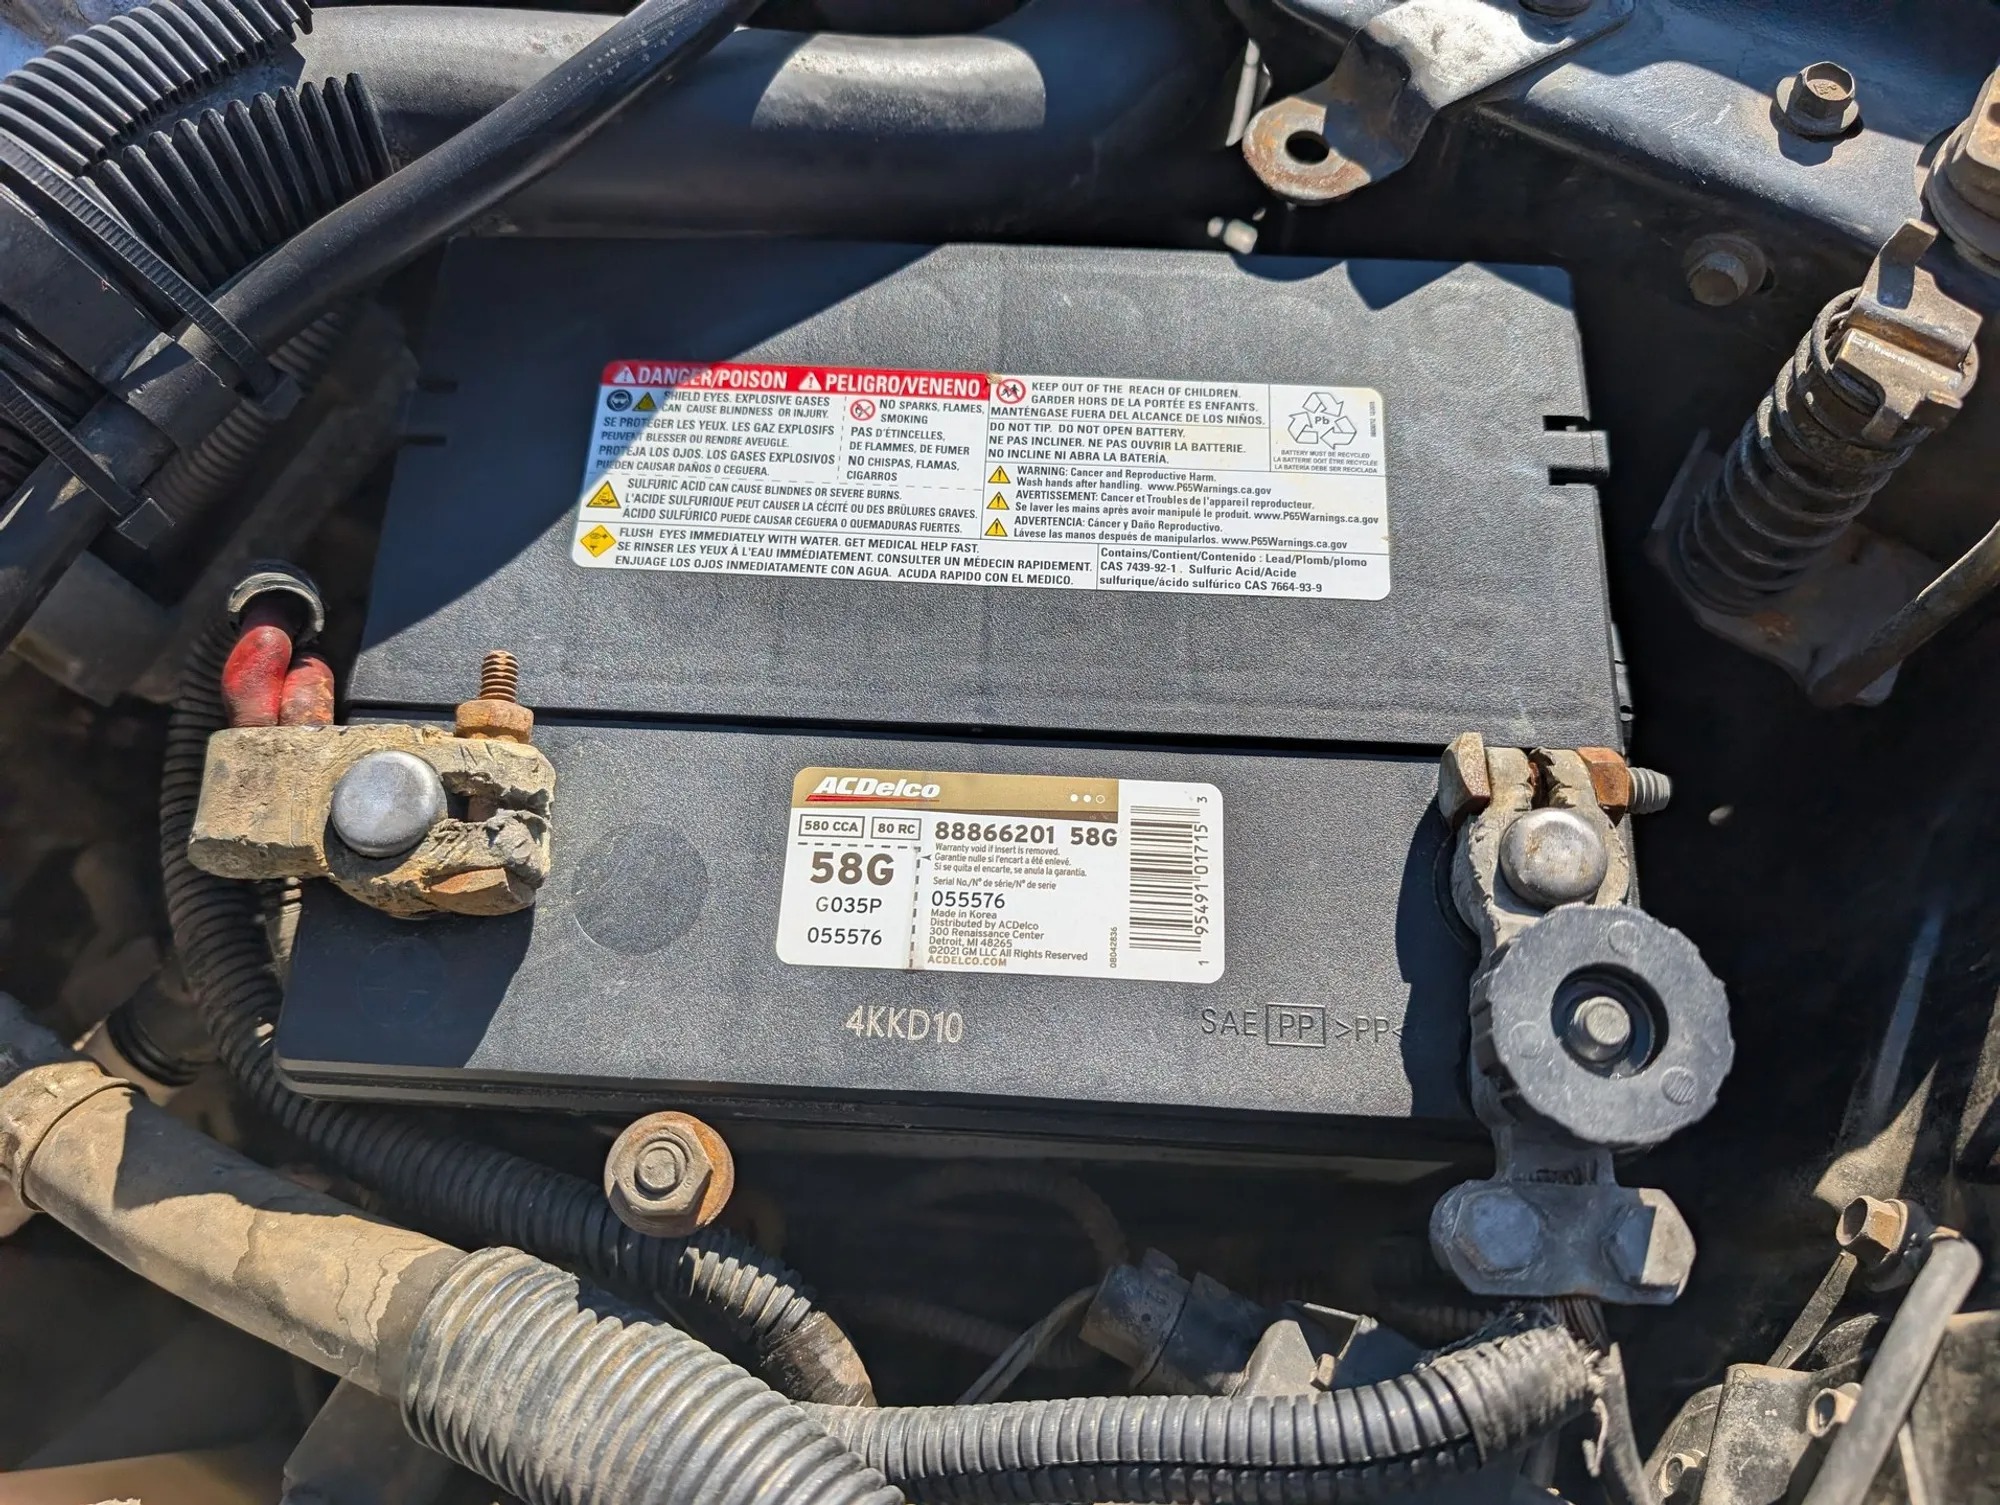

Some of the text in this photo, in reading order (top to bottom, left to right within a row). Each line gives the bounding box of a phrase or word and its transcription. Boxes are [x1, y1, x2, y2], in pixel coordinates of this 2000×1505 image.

[638, 368, 787, 388] DANGER/POISON
[826, 374, 980, 396] PELIGRO/VENENO
[1032, 382, 1238, 397] KEEP OUT OF THE REACH OF CHILDREN.
[662, 391, 830, 406] SHIELD EYES. EXPLOSIVE GASES
[1031, 395, 1075, 404] GARDER
[1078, 397, 1108, 406] HORS
[1111, 398, 1124, 406] DE
[1128, 398, 1141, 407] LA
[1144, 399, 1185, 408] PORTÉE
[1205, 402, 1257, 411] ENFANTS.
[660, 403, 828, 418] CAN CAUSE BLINDNESS OR INJURY.
[880, 400, 984, 414] NO SPARKS, FLAMES,
[881, 414, 928, 424] SMOKING
[1315, 417, 1330, 425] Pb
[851, 427, 945, 440] PAS D'ÉTINCELLES,
[990, 422, 1185, 437] DO NOT TIP. DO NOT OPEN BATTERY.
[849, 441, 970, 455] DE FLAMMES, DE FUMER
[988, 449, 1004, 458] NO
[1008, 450, 1050, 459] INCLINE
[1054, 451, 1066, 460] NI
[1069, 452, 1100, 460] ABRA
[1103, 452, 1117, 461] LA
[848, 456, 959, 470] NO CHISPAS, FLAMAS,
[847, 471, 897, 481] CIGARROS
[1018, 467, 1216, 481] WARNING: Cancer and Reproductive Harm.
[628, 478, 900, 499] SULFURIC ACID CAN CAUSE BLINDNES OR SEVERE BURNS.
[1045, 480, 1073, 488] hands
[1076, 480, 1097, 488] after
[1100, 481, 1142, 492] handling.
[1148, 483, 1271, 496] www.P65Warnings.ca.gov
[1014, 518, 1222, 532] ADVERTENCIA: Cáncer y Daño Reproductivo.
[620, 528, 979, 553] FLUSH EYES IMMEDIATELY WITH WATER. GET MEDICAL HELP FAST.
[814, 778, 940, 797] ACDelco
[805, 820, 858, 832] 580 CCA
[878, 823, 915, 834] 80 RC
[936, 822, 1117, 846] 88866201 58G
[936, 844, 970, 853] Warranty
[971, 845, 987, 853] void
[995, 846, 1016, 854] insert
[1018, 846, 1024, 854] is
[1025, 848, 1060, 856] removed.
[1194, 824, 1209, 875] 01715
[811, 852, 894, 885] 58G
[816, 898, 882, 913] G035P
[932, 892, 1005, 908] 055576
[931, 909, 997, 919] Made in Korea
[1194, 883, 1209, 935] 95491
[930, 920, 1039, 930] Distributed by ACDelco
[808, 928, 882, 945] 055576
[952, 929, 1010, 938] Renaissance
[1012, 931, 1045, 940] Center
[929, 938, 1013, 948] Detroit, MI 48265
[928, 956, 1007, 966] ACDELCO.COM
[845, 1005, 964, 1043] 4KKD10
[1201, 1006, 1258, 1036] SAE
[1278, 1012, 1314, 1039] PP
